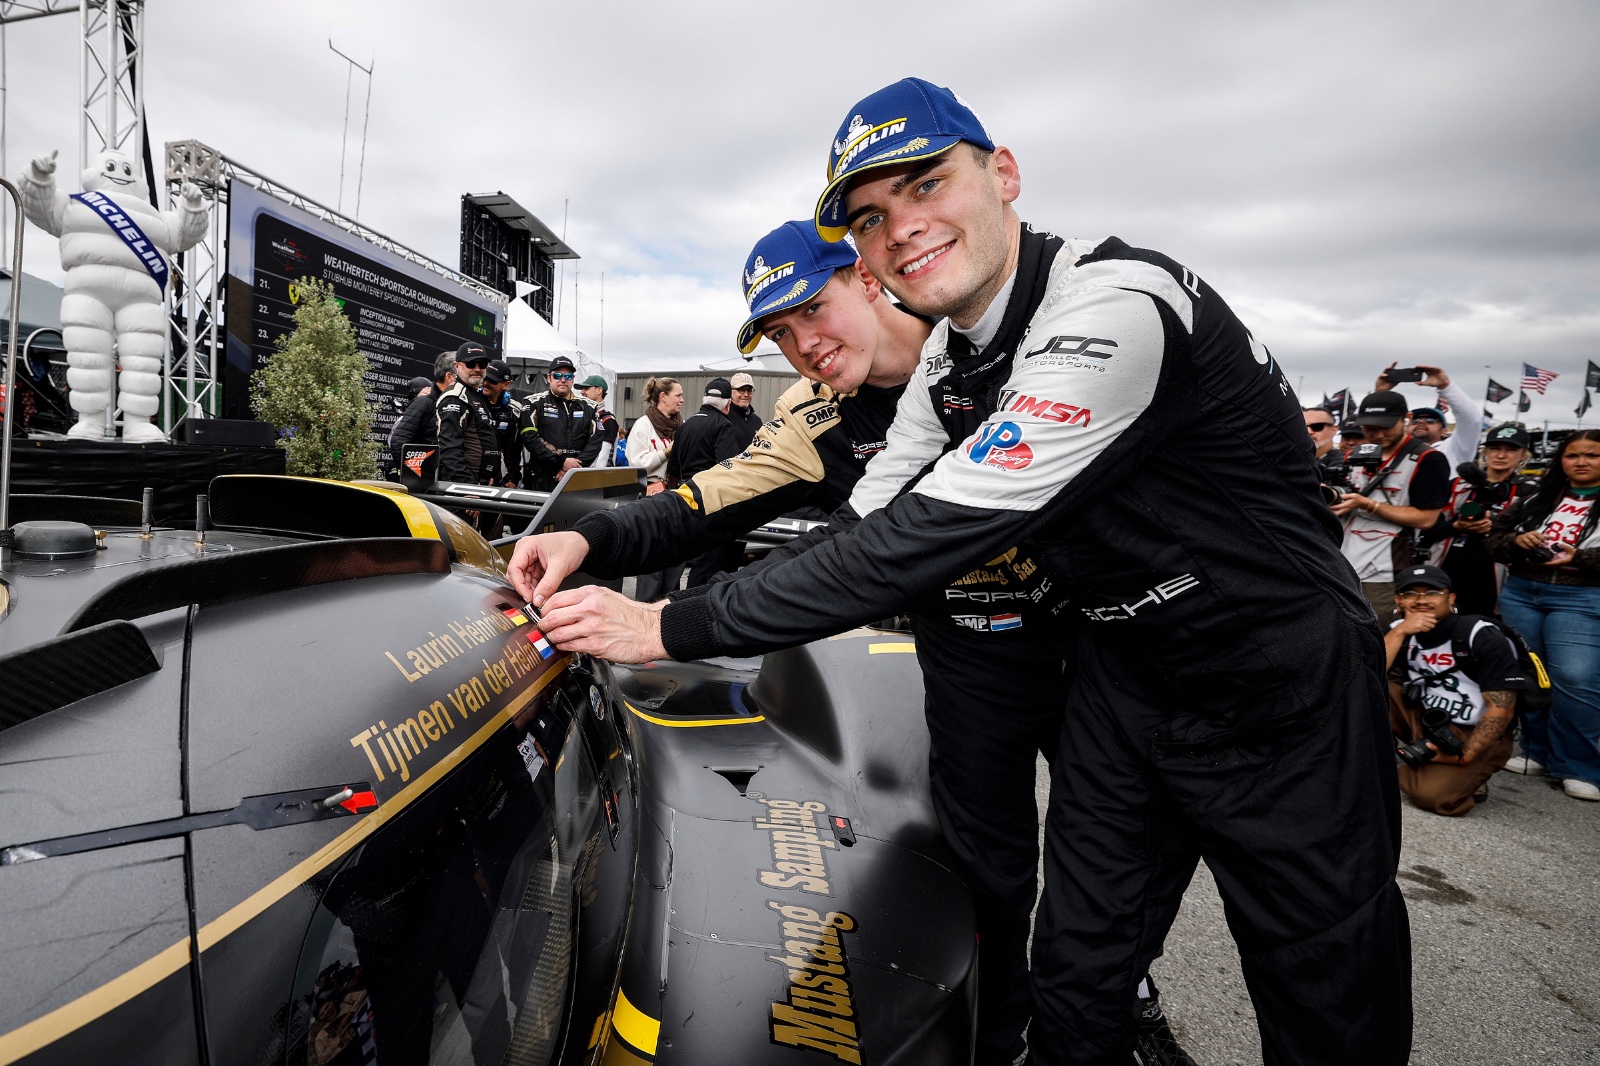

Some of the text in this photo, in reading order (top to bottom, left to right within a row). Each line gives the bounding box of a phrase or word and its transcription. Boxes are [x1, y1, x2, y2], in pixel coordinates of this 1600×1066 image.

[80, 191, 165, 274] MICHELIN
[259, 278, 270, 290] 21.
[322, 268, 447, 321] STUBHUB MONTEREY SPORTSCAR CHAMPIONSHIP
[324, 253, 379, 285] WEATHERTECH
[379, 276, 417, 300] SPORTSCAR
[417, 292, 457, 315] CHAMPIONSHIP
[258, 304, 269, 315] 22.
[360, 307, 405, 329] INCEPTION RACING
[258, 328, 269, 339] 23.
[360, 328, 415, 351] WRIGHT MOTORSPORTS
[473, 325, 487, 336] ROLEX
[1025, 335, 1119, 360] JDC
[384, 355, 402, 367] RACING
[378, 373, 402, 386] SULLIVAN
[805, 405, 836, 425] OMP
[1008, 394, 1092, 428] IMSA
[406, 451, 427, 459] SPEED
[987, 449, 1034, 466] Racing
[1545, 520, 1585, 546] 83
[384, 608, 516, 683] Laurin Heinrich
[350, 640, 543, 782] Tijmen van der Helm
[756, 798, 862, 1066] Mustang Sampling
